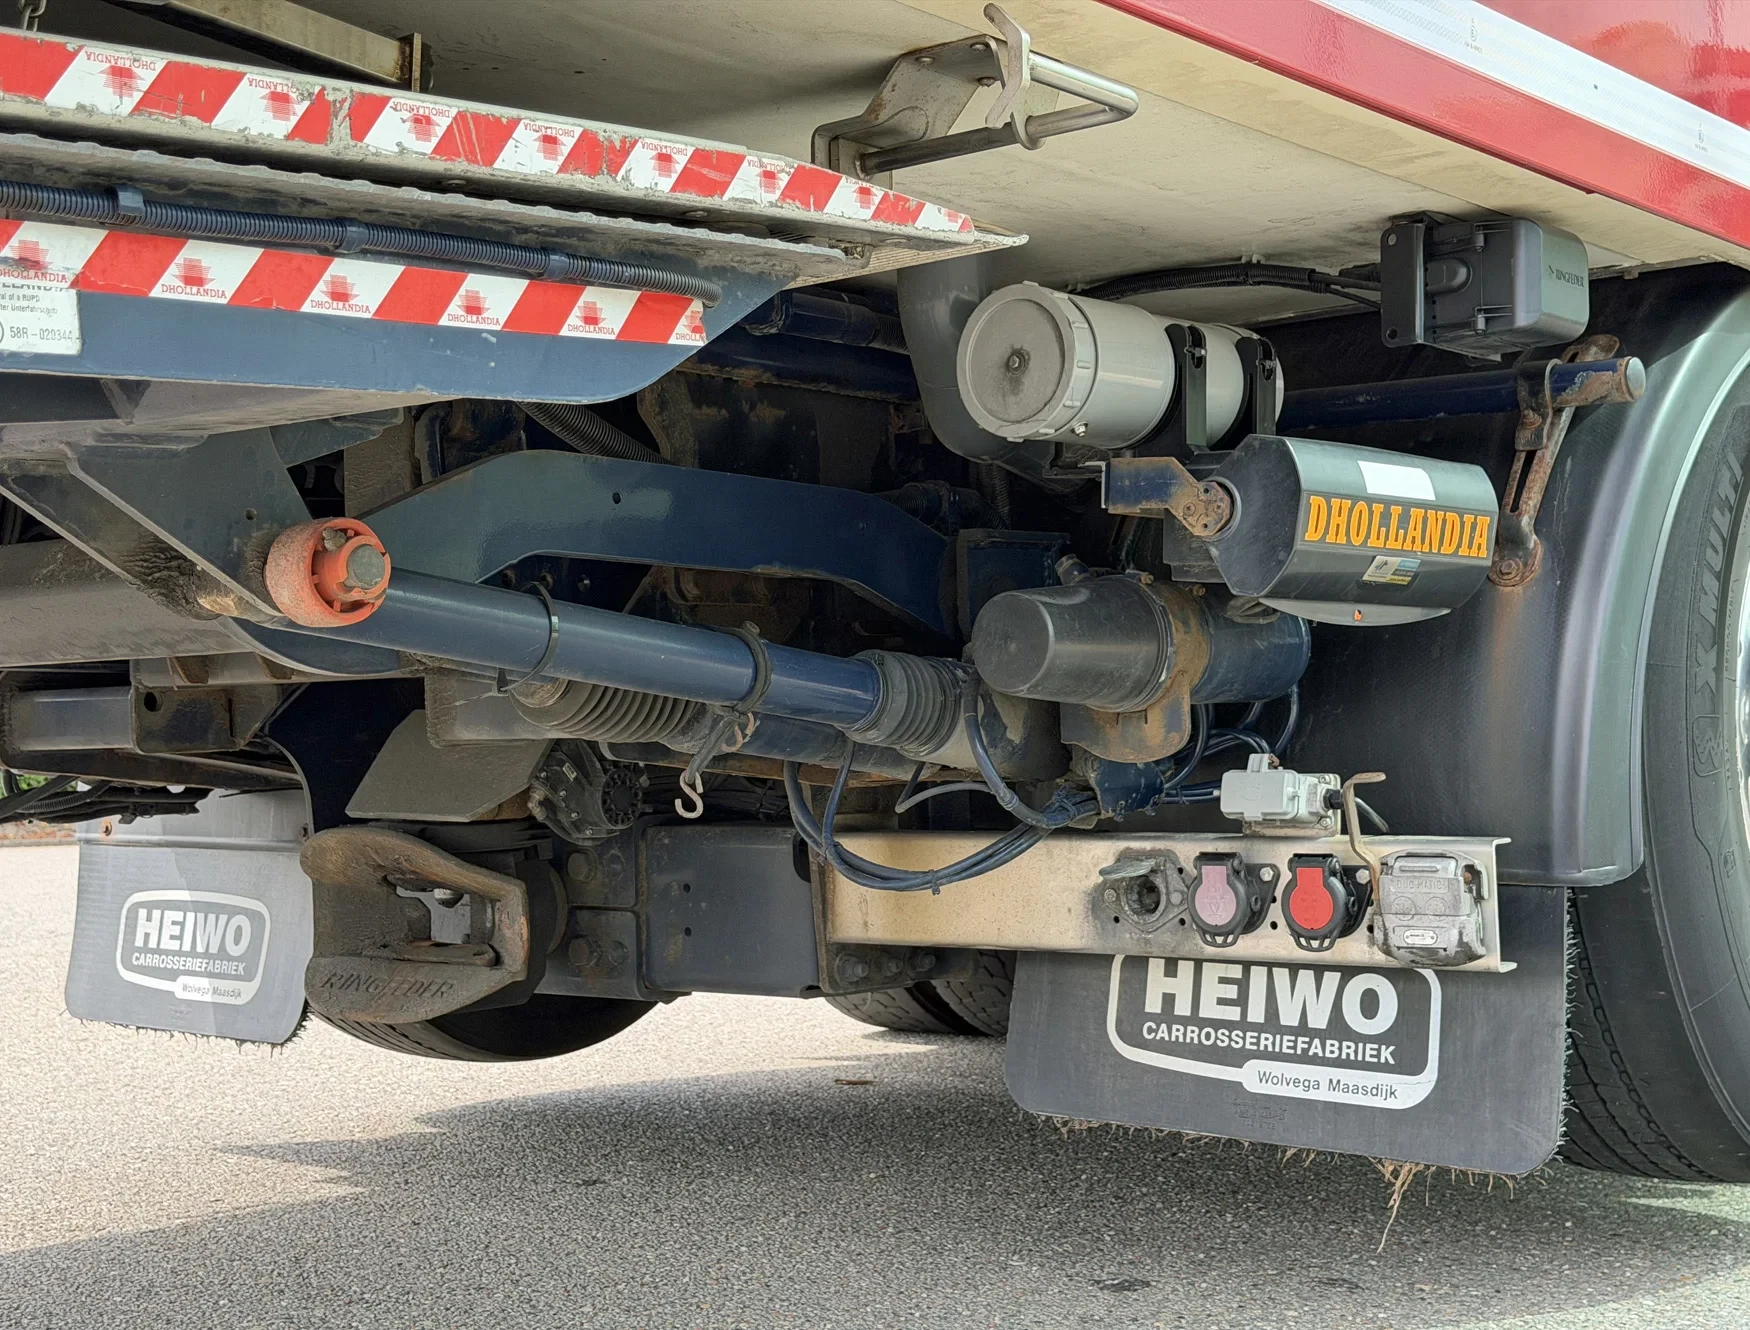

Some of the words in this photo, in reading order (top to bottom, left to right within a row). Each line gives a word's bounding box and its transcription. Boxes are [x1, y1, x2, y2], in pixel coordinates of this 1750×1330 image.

[85, 51, 156, 71] DHOLLANDIA
[392, 100, 450, 118] DHOLLANDIA
[523, 122, 575, 138] DHOLLANDIA
[640, 141, 688, 156] DHOLLANDIA
[1555, 269, 1584, 288] RINGFEDER
[161, 283, 228, 300] DHOLLANDIA
[310, 299, 371, 315] DHOLLANDIA
[447, 313, 501, 326] DHOLLANDIA
[10, 326, 29, 340] 58R
[567, 323, 616, 336] DHOLLANDIA
[1304, 495, 1490, 558] DHOLLANDIA
[134, 907, 252, 957] HEIWO
[132, 952, 247, 976] CARROSSERIEFABRIEK
[182, 983, 210, 996] Wolvega
[211, 986, 242, 999] Maasdijk
[1144, 957, 1399, 1035] HEIWO
[1142, 1021, 1396, 1064] CARROSSERIEFABRIEK
[1257, 1070, 1321, 1092] Wolvega
[1328, 1078, 1398, 1100] Maasdijk
